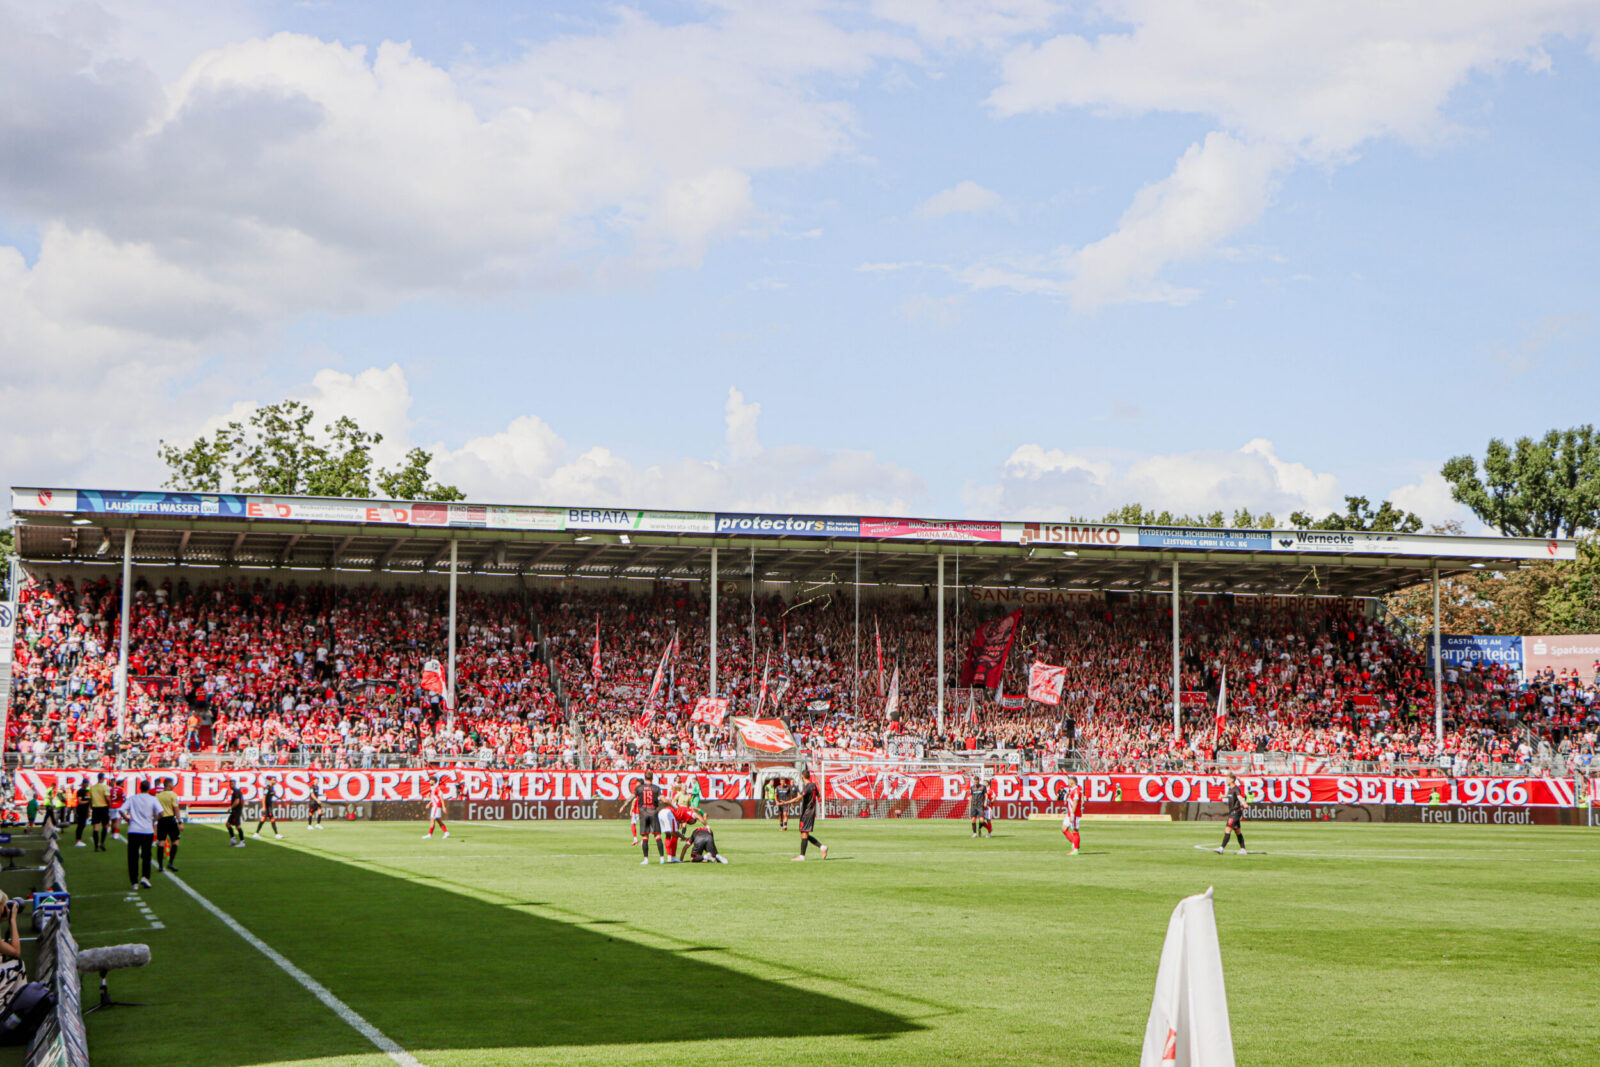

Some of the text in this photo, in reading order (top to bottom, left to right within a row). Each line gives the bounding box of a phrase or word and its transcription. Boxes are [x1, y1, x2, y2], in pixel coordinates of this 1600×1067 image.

[105, 501, 200, 513] LAUSITZER WASSER
[569, 509, 630, 523] BERATA
[717, 516, 825, 531] protectors
[908, 522, 947, 530] IMMOBILIEN
[956, 524, 1000, 532] WOHNDESIGN
[1045, 525, 1120, 544] ISIMKO
[1139, 529, 1183, 537] OSTDEUTSCHE
[1185, 530, 1228, 538] SICHERHEITS-
[1296, 532, 1354, 544] Wernecke
[1163, 538, 1197, 546] LEISTUNGS
[481, 751, 491, 759] 20
[698, 751, 707, 760] 21
[941, 775, 1113, 801] EERGIE
[1337, 776, 1421, 805] SEIT
[1446, 778, 1528, 805] 1966
[468, 802, 603, 820] Freu Dich drauf.
[1007, 801, 1038, 819] Dich
[1241, 805, 1311, 820] eldschlößchen
[1421, 807, 1534, 825] Freu Dich drauf.
